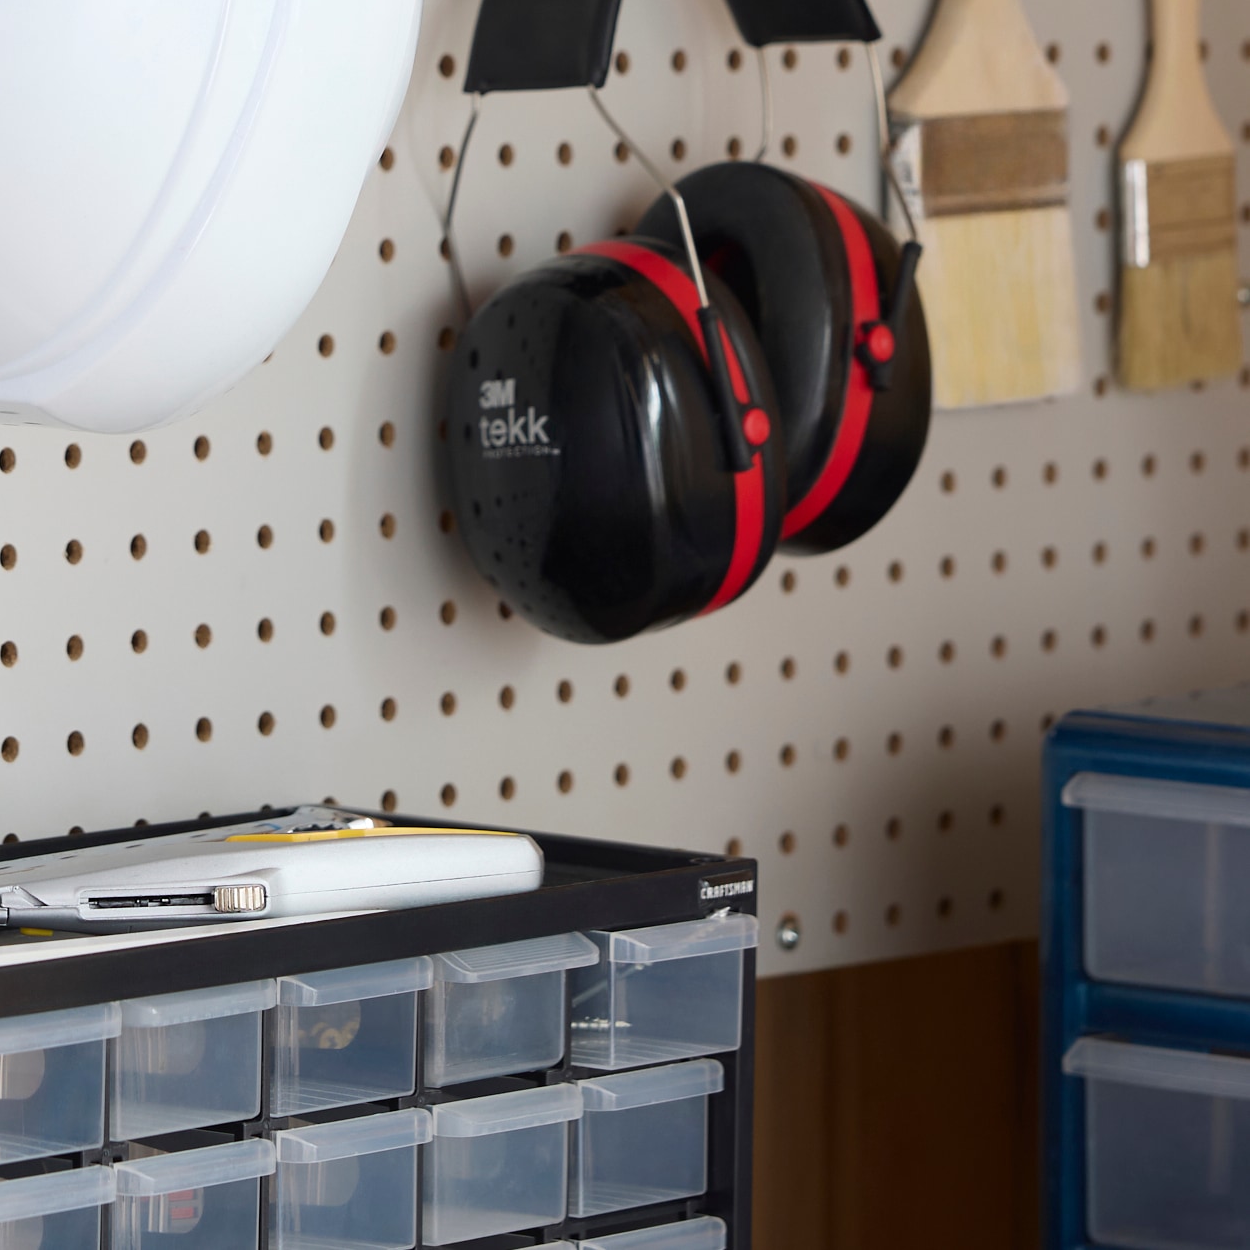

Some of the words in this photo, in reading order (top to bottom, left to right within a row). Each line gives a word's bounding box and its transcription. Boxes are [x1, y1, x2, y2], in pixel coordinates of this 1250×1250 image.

[478, 377, 516, 410] 3M
[478, 406, 550, 448] tekk
[700, 879, 754, 900] CRAFTSMAN
